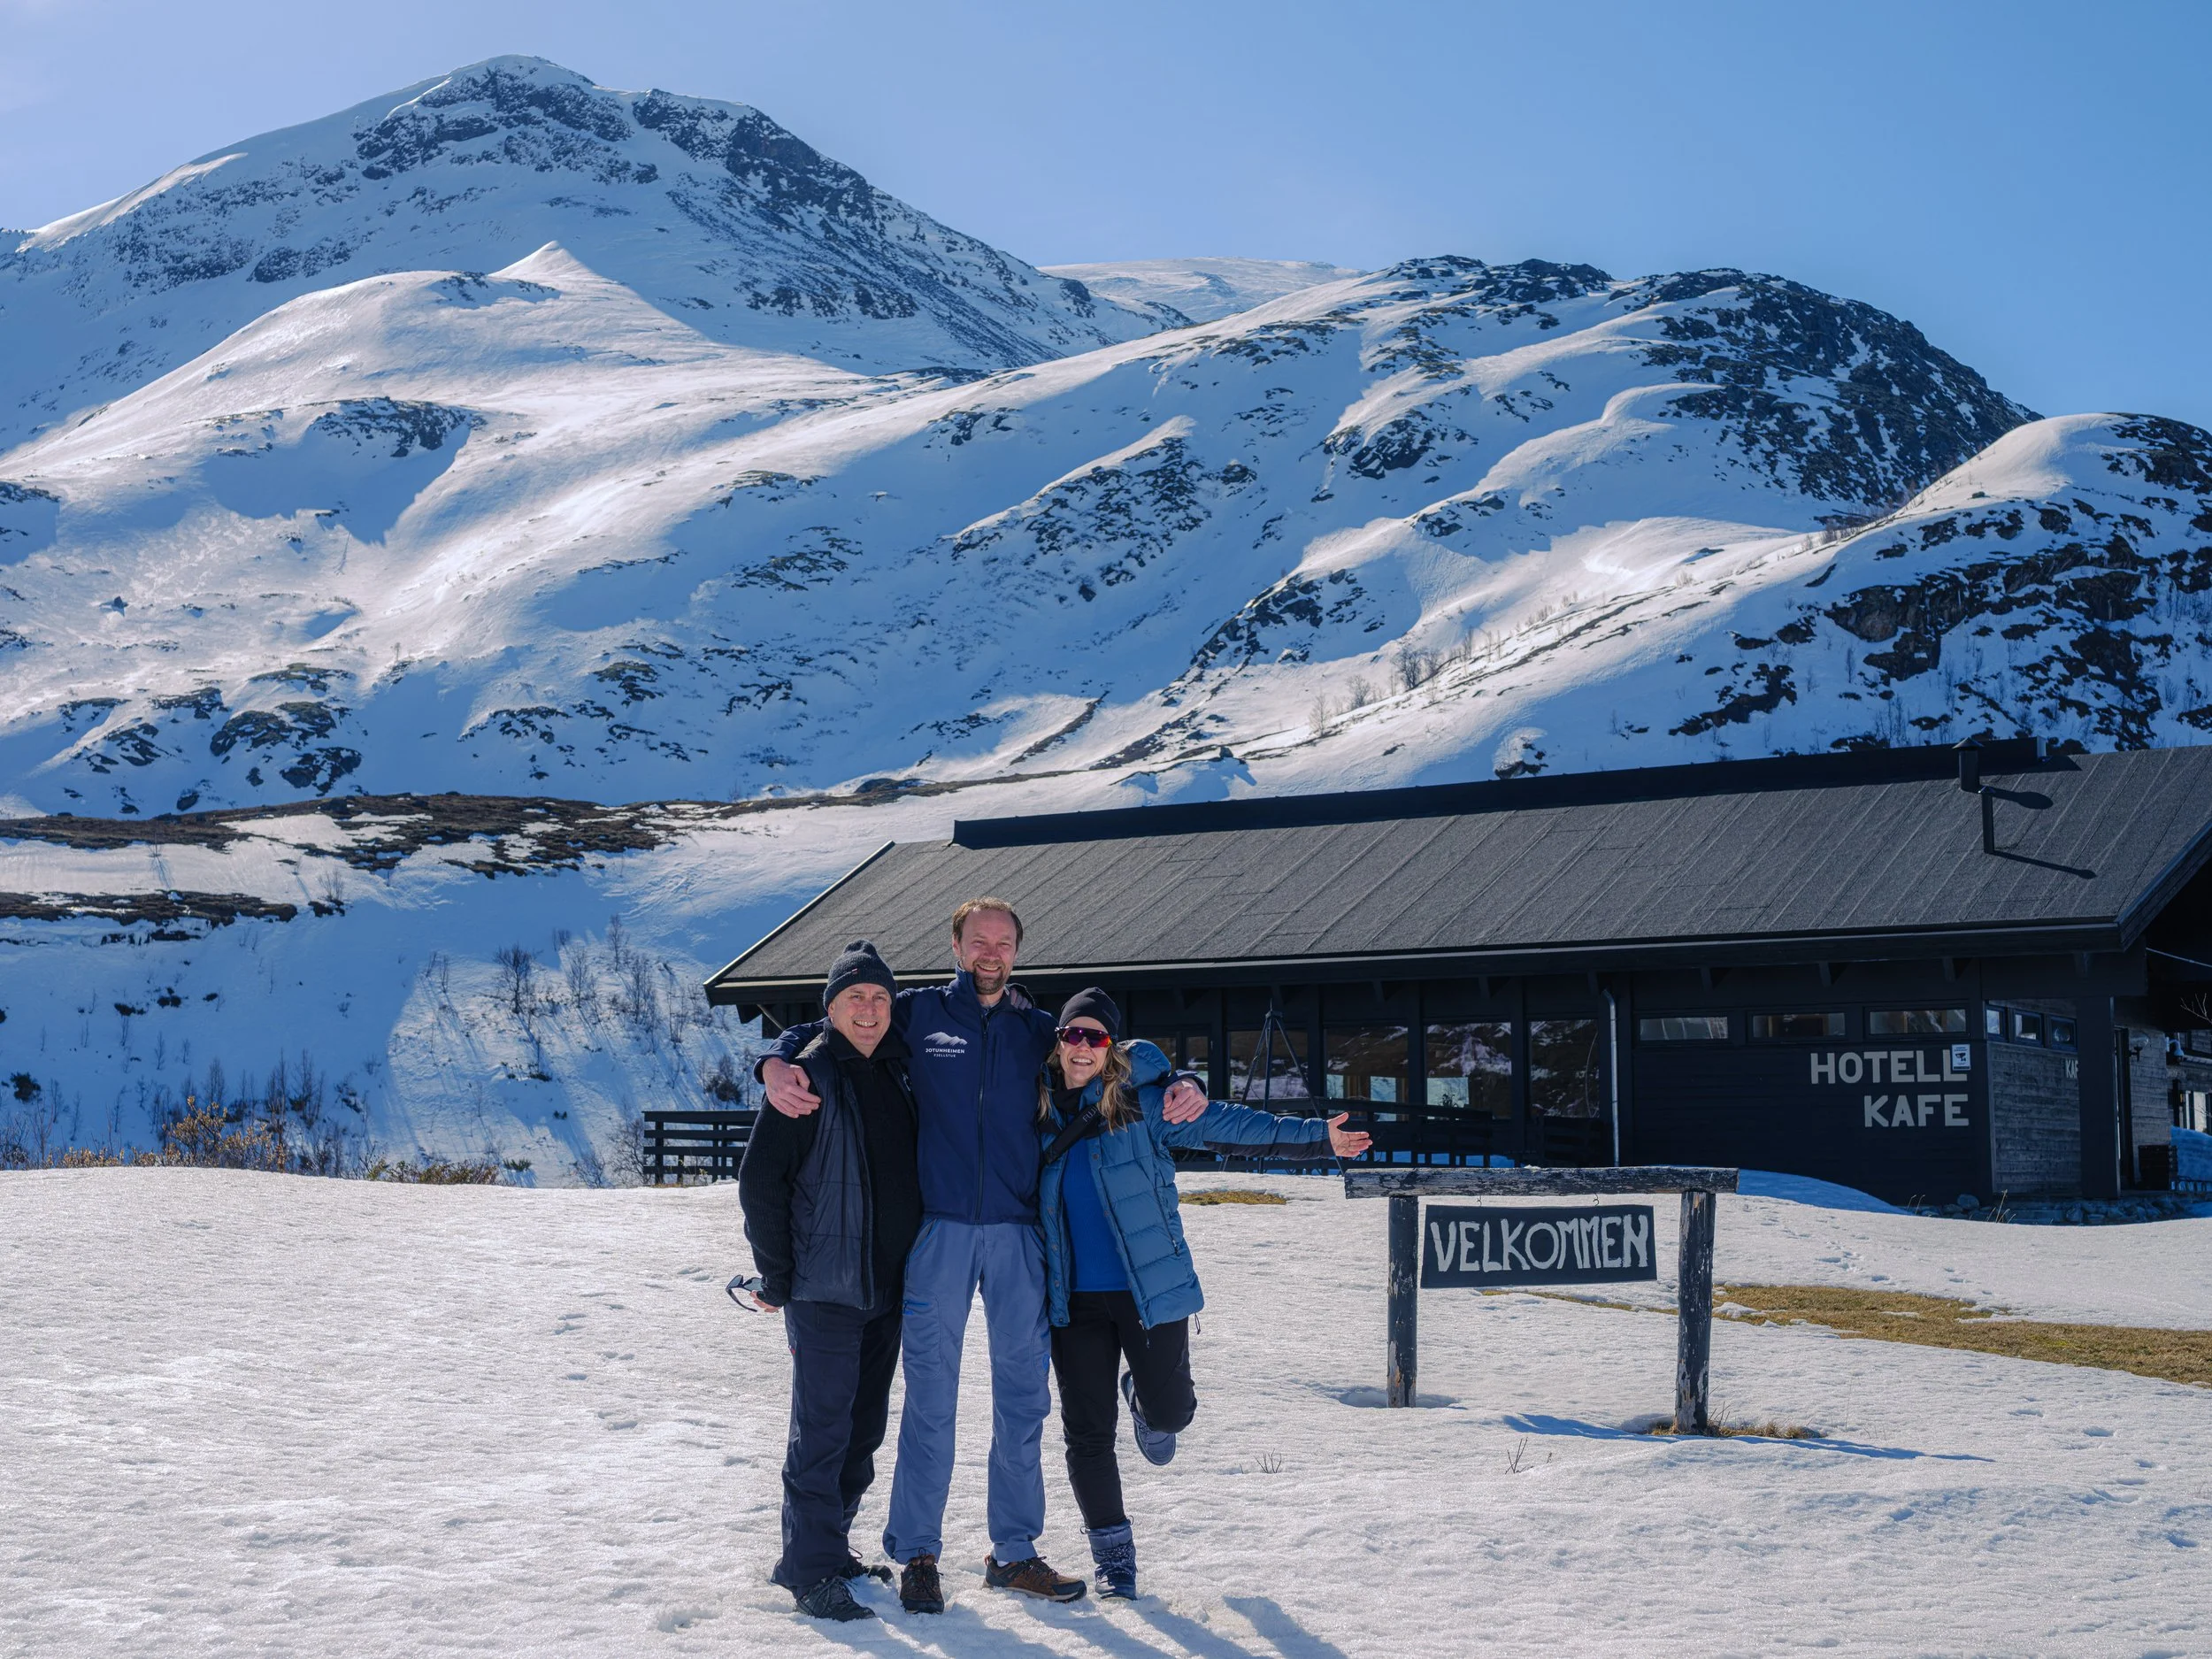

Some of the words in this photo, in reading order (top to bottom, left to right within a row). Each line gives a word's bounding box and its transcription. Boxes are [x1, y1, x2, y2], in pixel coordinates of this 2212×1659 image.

[1810, 1049, 1968, 1085] HOTELL
[1864, 1094, 1970, 1127] KAFE
[1430, 1214, 1648, 1272] VELKOMMEN
